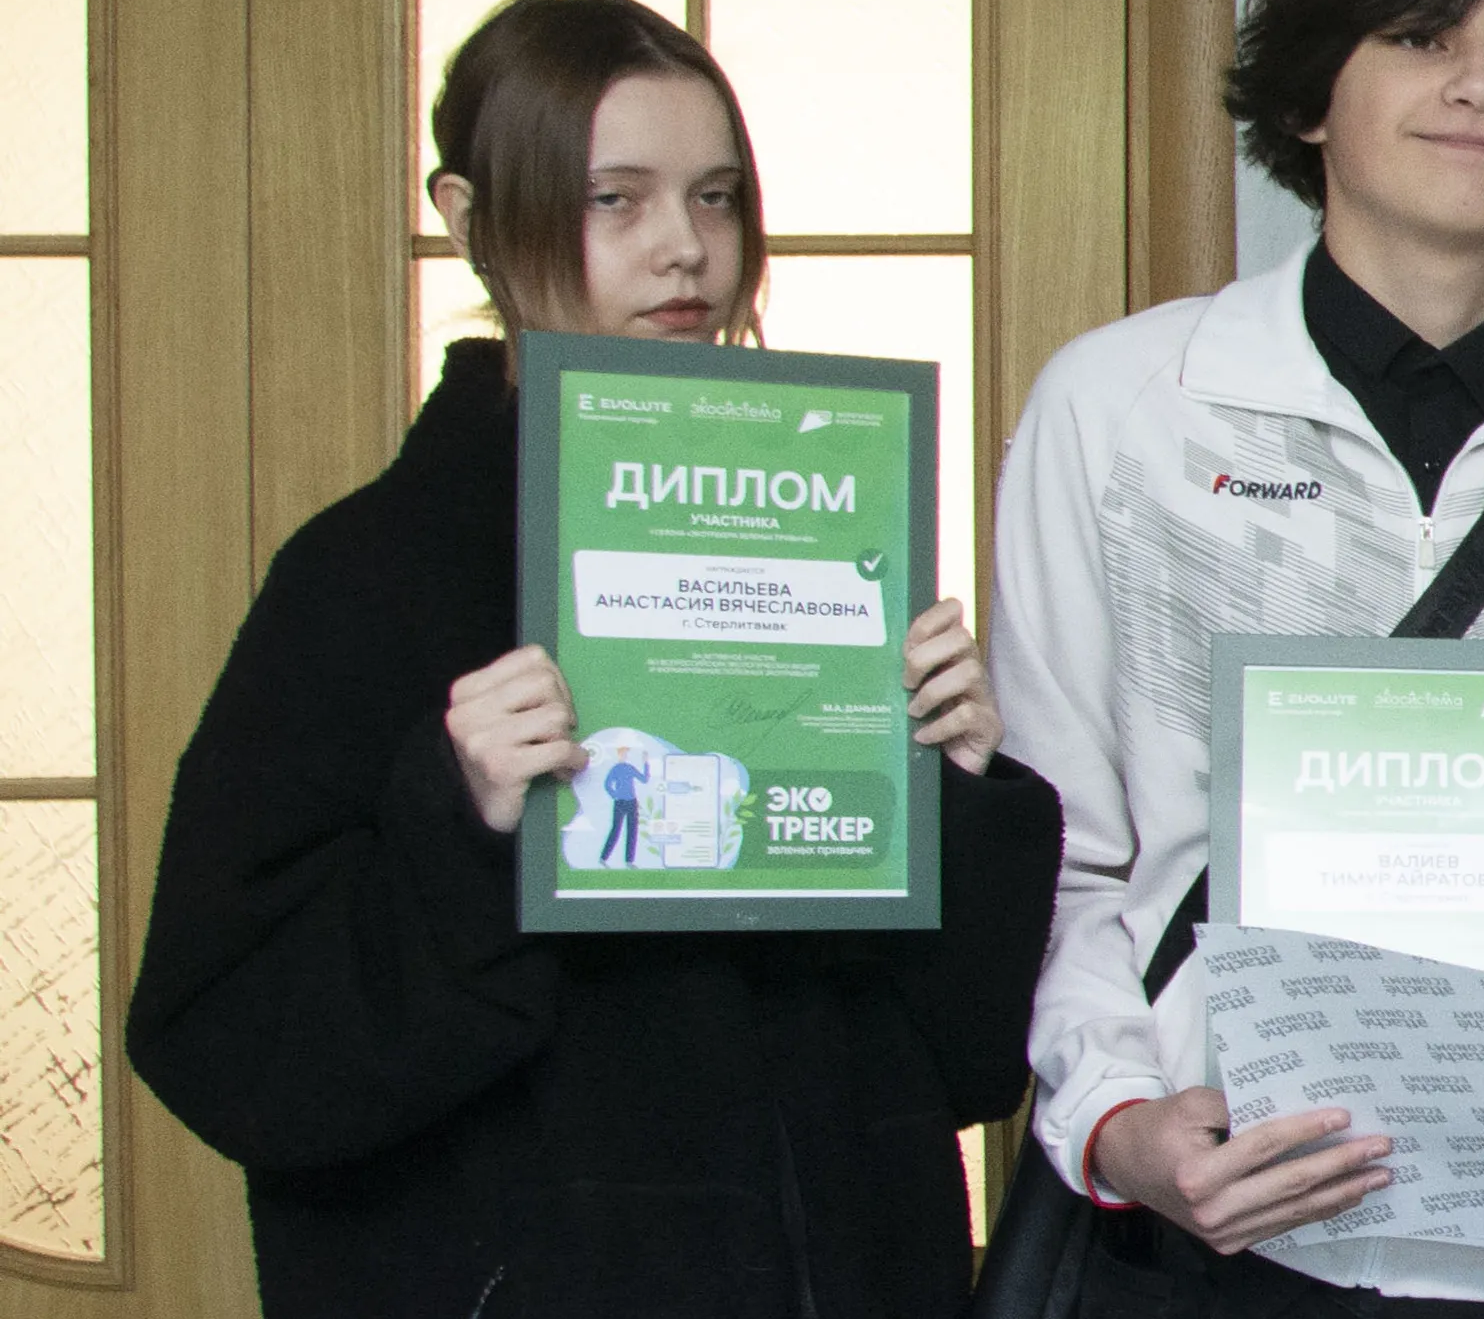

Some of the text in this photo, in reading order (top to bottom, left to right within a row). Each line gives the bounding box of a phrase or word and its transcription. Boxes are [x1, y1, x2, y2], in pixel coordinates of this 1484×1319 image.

[600, 397, 672, 414] EVOLUTE
[606, 461, 856, 513] ДИПЛОМ
[1213, 475, 1322, 501] FORWARD
[690, 513, 780, 530] УЧАСТНИКА
[679, 579, 791, 598] ВАСИЛЬЕВА
[595, 594, 869, 618] АНАСТАСИЯ ВЯЧЕСЛАВОВНА
[695, 618, 788, 633] Стерлитамак
[766, 786, 832, 812] ЭКО
[766, 816, 874, 842] ТРЕКЕР
[1378, 854, 1460, 870] ВАЛИЕВ
[1320, 871, 1391, 888] ТИМУР
[1204, 945, 1277, 966] ECONOMY
[1208, 953, 1283, 977] attaché
[1280, 975, 1350, 989] ECONOMY
[1285, 982, 1357, 1000] attaché
[1253, 1011, 1326, 1030] ECONOMY
[1258, 1019, 1331, 1042] attaché
[1227, 1050, 1299, 1079] ECONOMY
[1232, 1058, 1305, 1089] attaché
